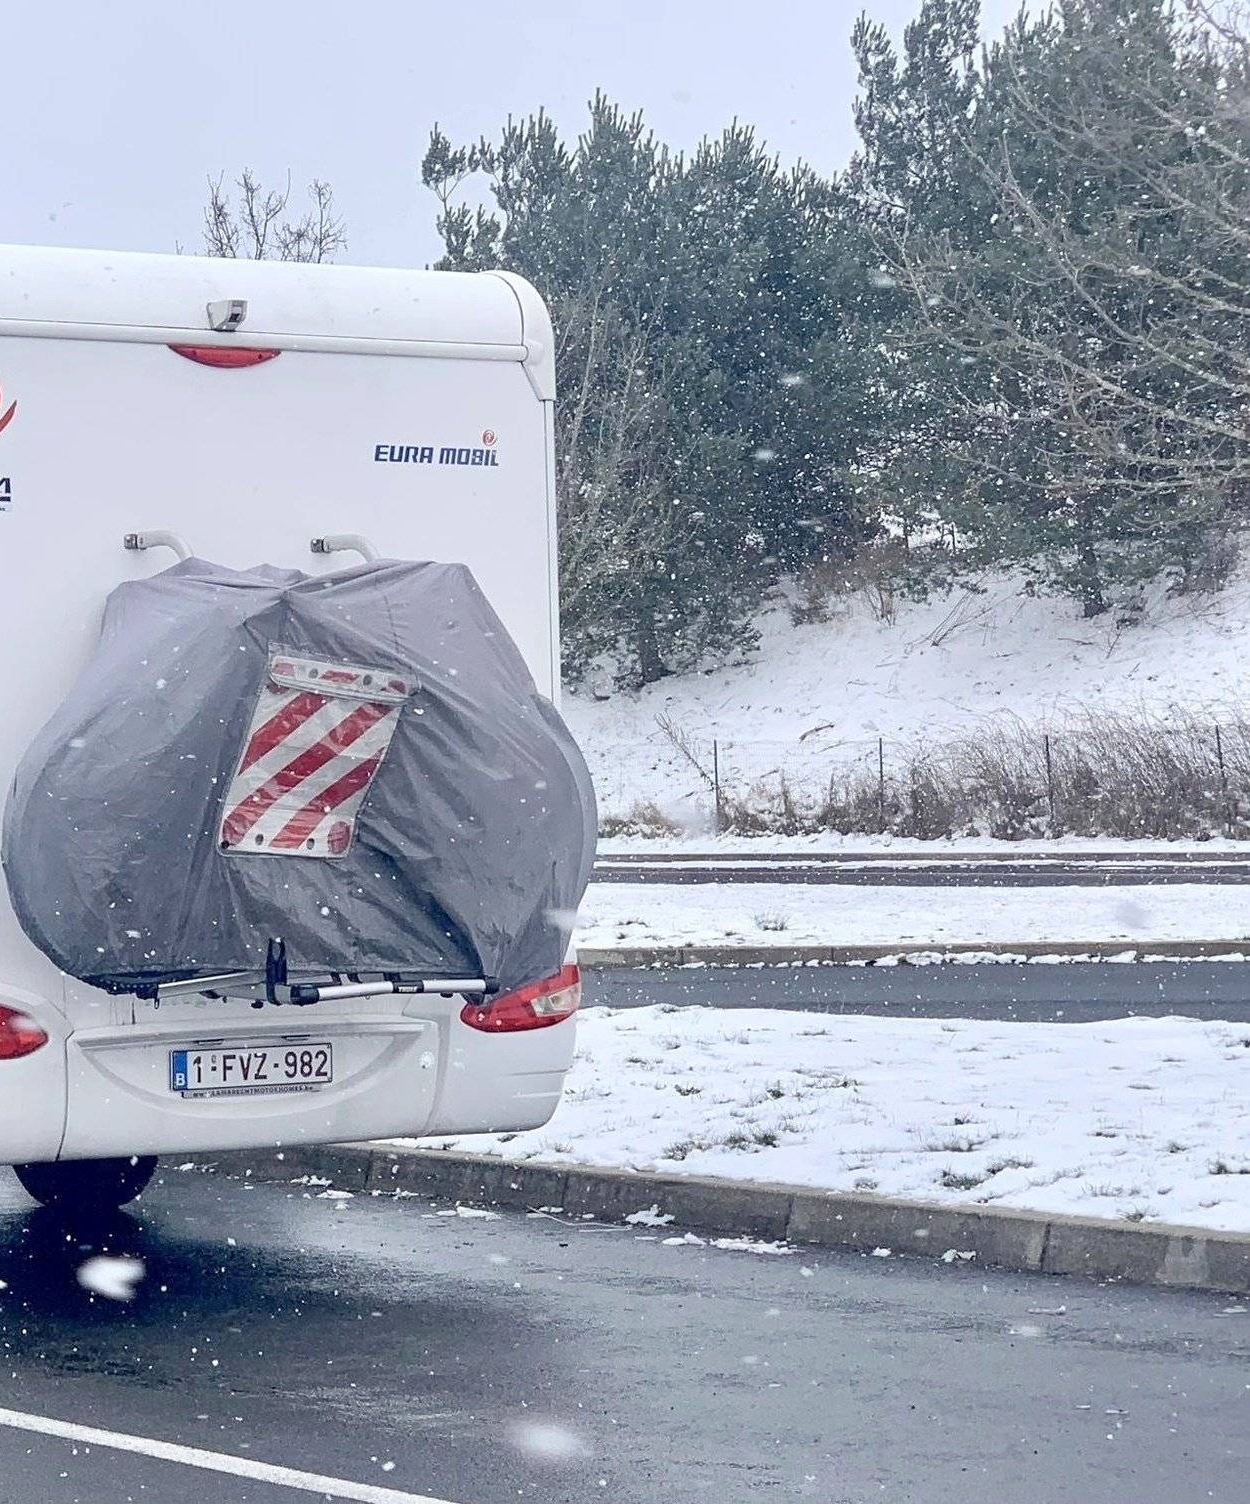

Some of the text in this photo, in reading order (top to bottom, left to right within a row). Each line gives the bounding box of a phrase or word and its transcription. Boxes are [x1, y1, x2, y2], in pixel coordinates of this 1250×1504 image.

[374, 445, 499, 466] EURA MOBIL
[175, 1073, 186, 1086] B
